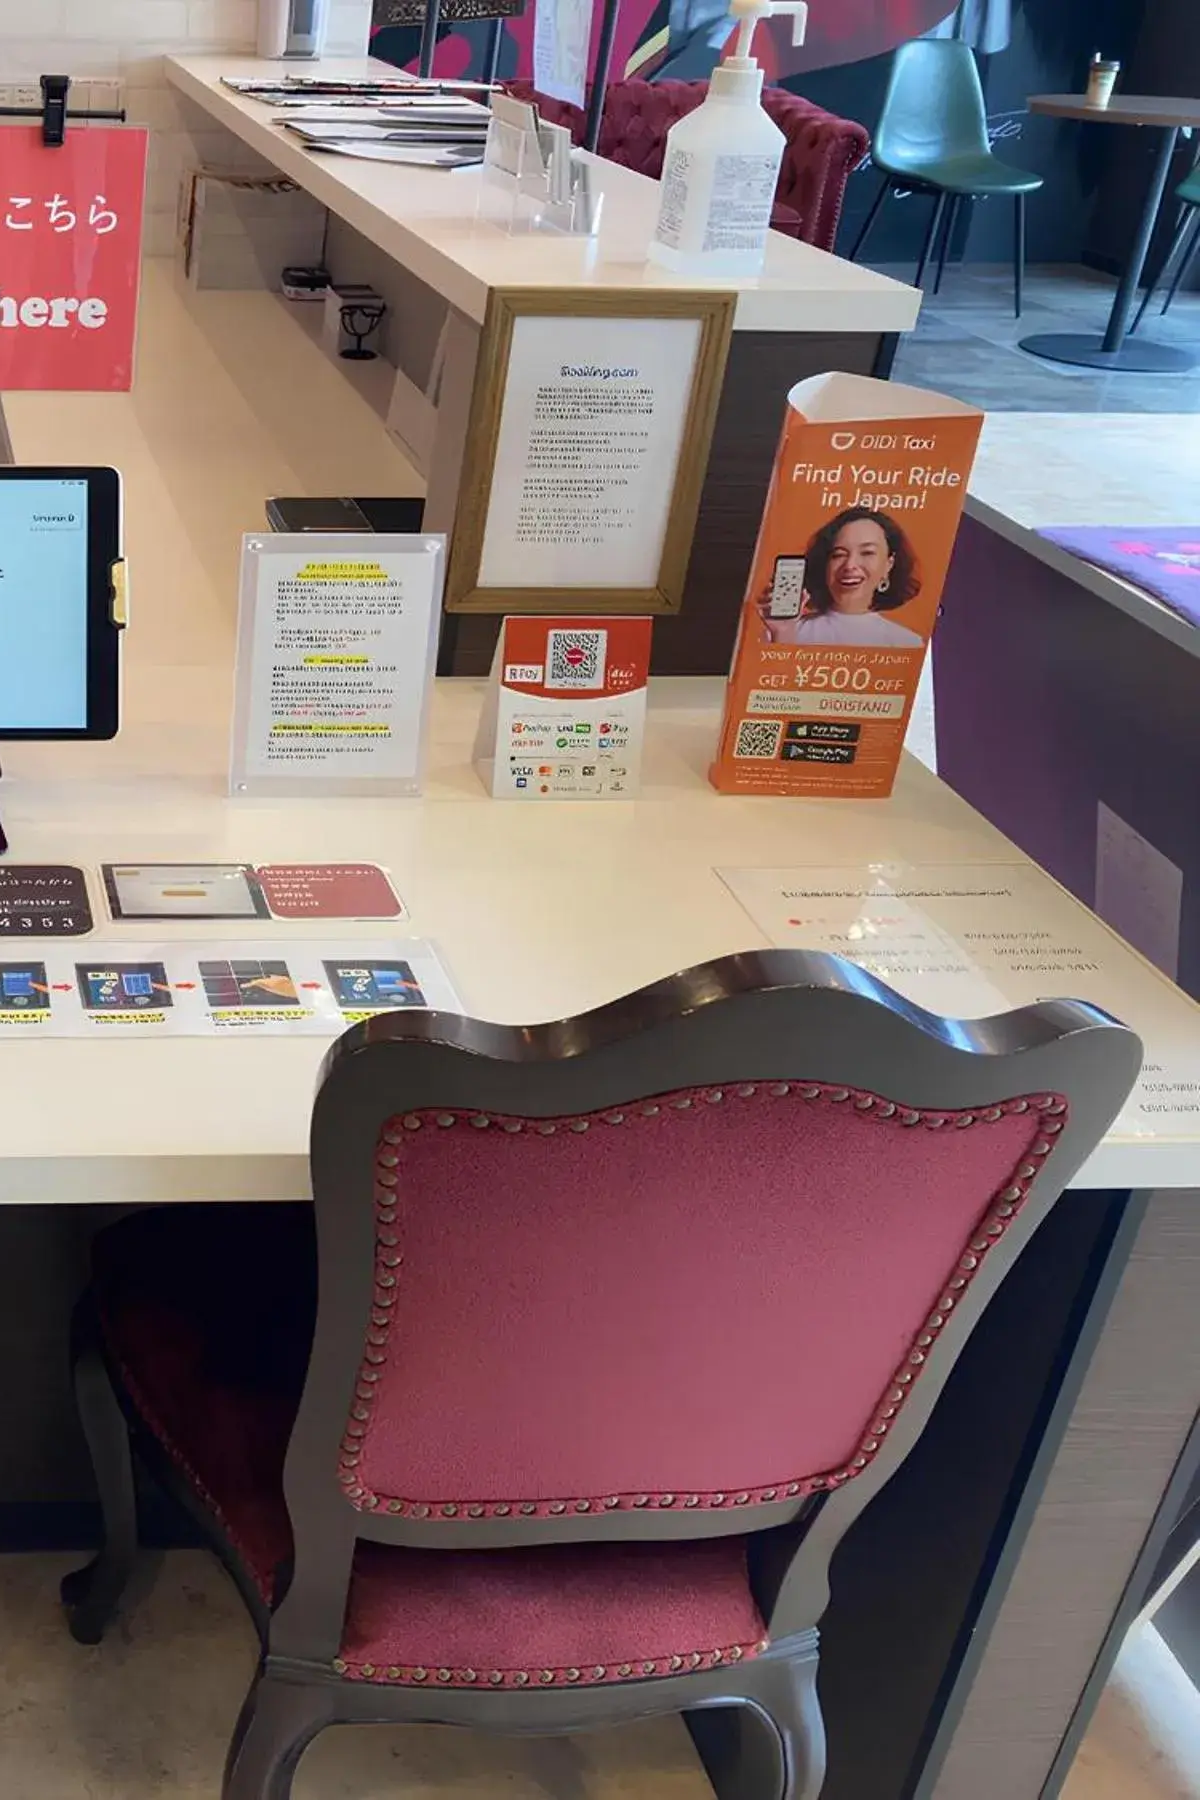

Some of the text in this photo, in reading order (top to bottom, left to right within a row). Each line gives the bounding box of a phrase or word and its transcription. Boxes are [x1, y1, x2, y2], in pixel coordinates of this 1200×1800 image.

[902, 434, 936, 450] Taxi
[792, 463, 960, 487] Find Your Ride
[821, 487, 928, 512] in Japan!
[758, 665, 905, 692] GET ¥500 OFF
